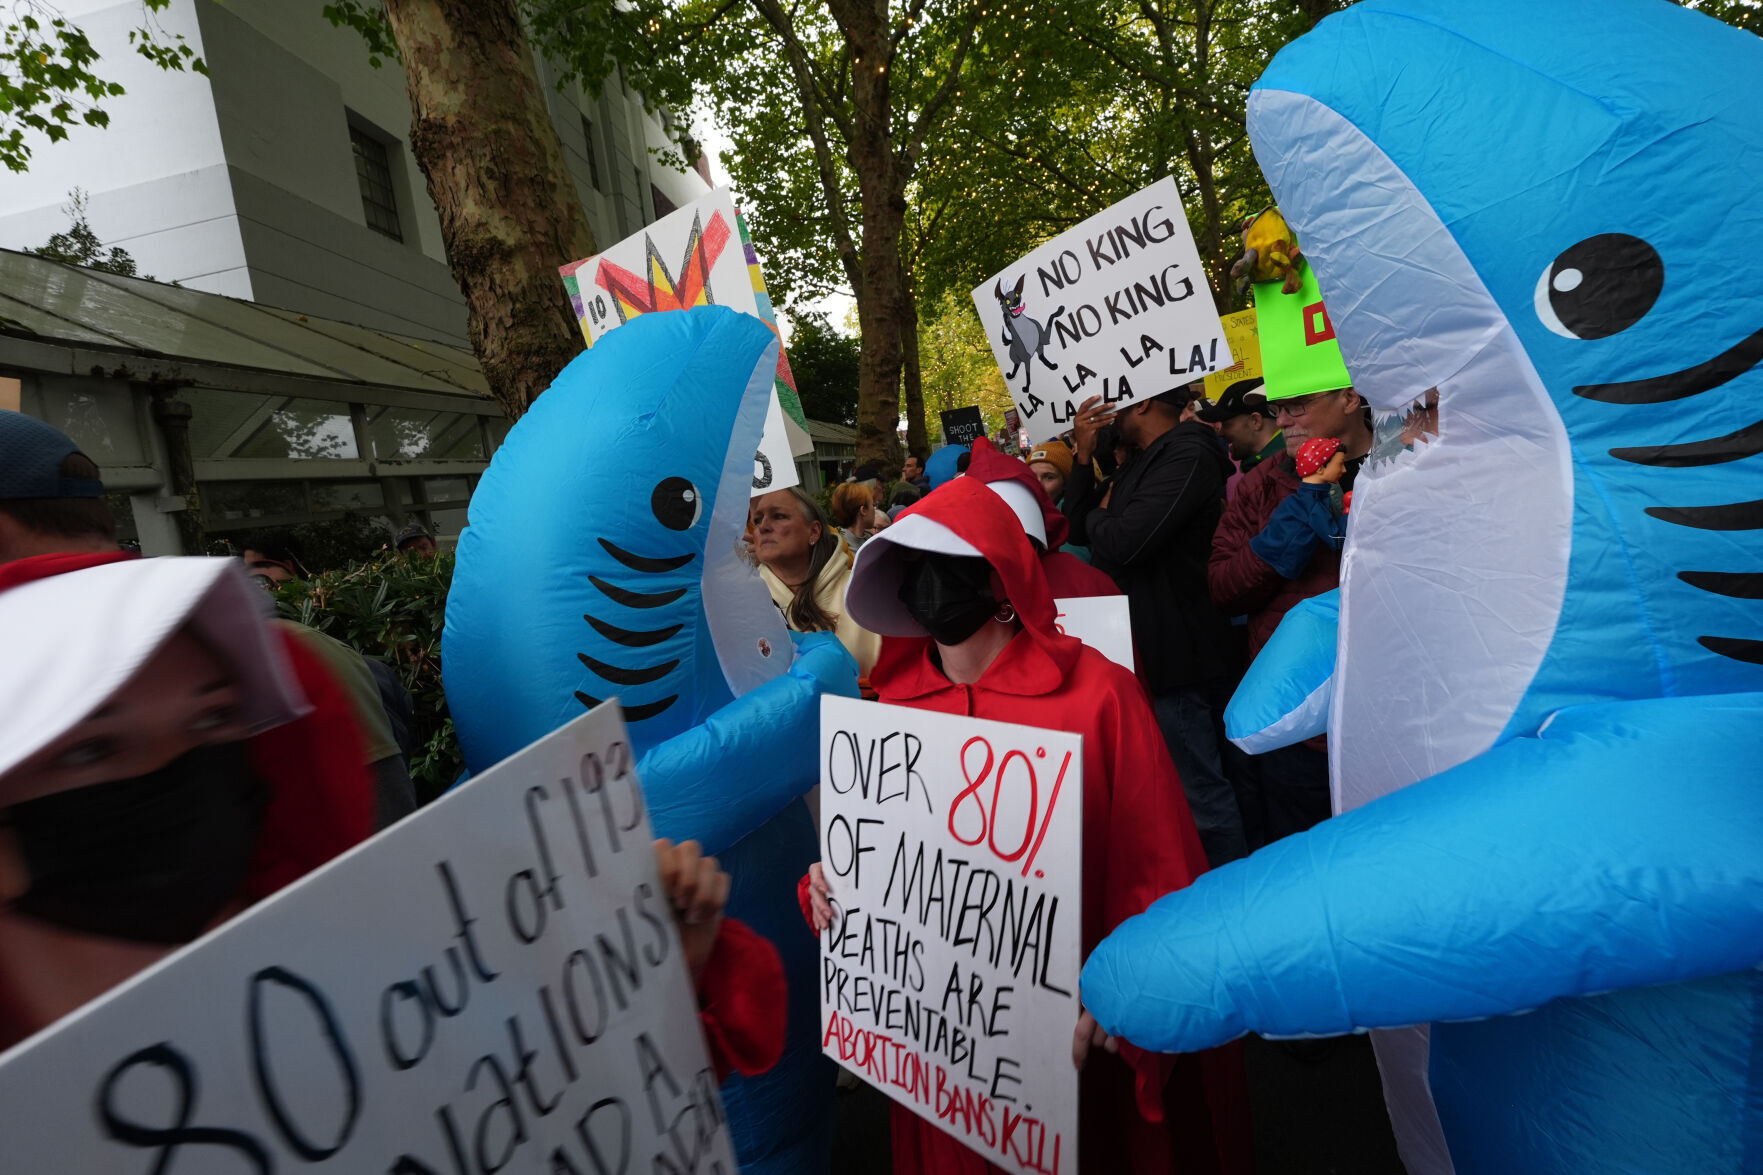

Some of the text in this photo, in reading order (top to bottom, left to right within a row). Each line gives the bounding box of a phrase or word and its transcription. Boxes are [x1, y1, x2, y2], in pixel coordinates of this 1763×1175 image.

[1037, 206, 1175, 298] NO KING
[1055, 264, 1194, 350] NO KING
[1019, 334, 1164, 419] LA LA LA
[1051, 400, 1077, 424] LA
[1103, 375, 1134, 403] LA
[1169, 338, 1218, 375] LA!
[949, 423, 977, 434] SHOOT
[959, 433, 975, 443] THE
[560, 741, 643, 880] 193
[829, 730, 1073, 878] OVER 80%
[827, 814, 1072, 998] OF MATERNAL
[826, 897, 1014, 1037] DEATHS ARE
[823, 1010, 930, 1106] ABORTION
[935, 1065, 997, 1149] BANS
